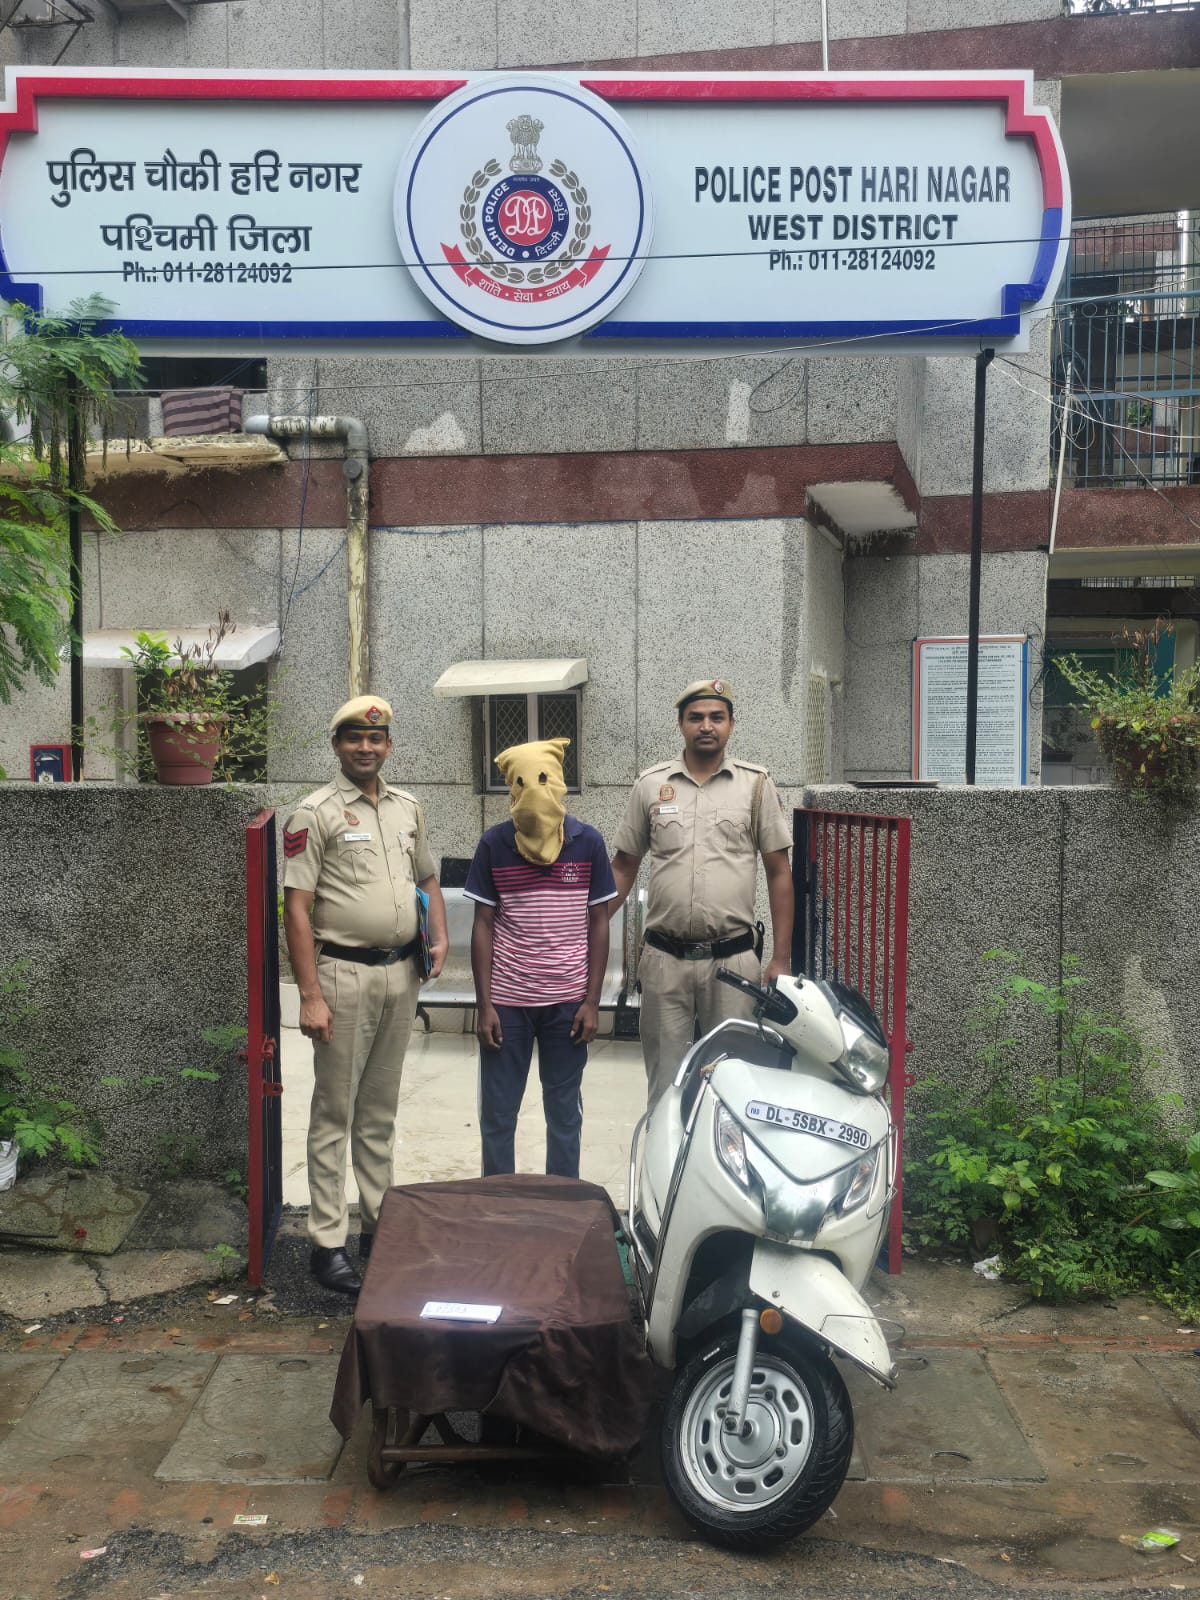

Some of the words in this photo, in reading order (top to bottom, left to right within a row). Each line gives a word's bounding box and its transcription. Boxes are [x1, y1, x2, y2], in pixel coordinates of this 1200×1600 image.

[46, 147, 136, 208] पुलिस
[144, 148, 221, 192] चौकी
[229, 149, 282, 195] हरि
[288, 163, 362, 194] नगर
[694, 166, 782, 204] POLICE
[789, 166, 853, 204] POST
[860, 166, 919, 203] HARI
[927, 166, 1011, 203] NAGAR
[485, 182, 510, 223] POLICE
[100, 213, 217, 252] पश्चिमी
[226, 213, 312, 253] जिला
[487, 227, 515, 257] DELHI
[748, 214, 824, 241] WEST
[832, 214, 959, 241] DISTRICT
[163, 261, 293, 284] 011-28124092
[768, 250, 803, 271] Ph.:
[808, 250, 936, 271] 011-28124092
[478, 278, 502, 297] शांति
[513, 289, 534, 303] सेवा
[545, 280, 571, 298] न्याय
[766, 1106, 783, 1123] DL
[838, 1125, 867, 1147] 2990
